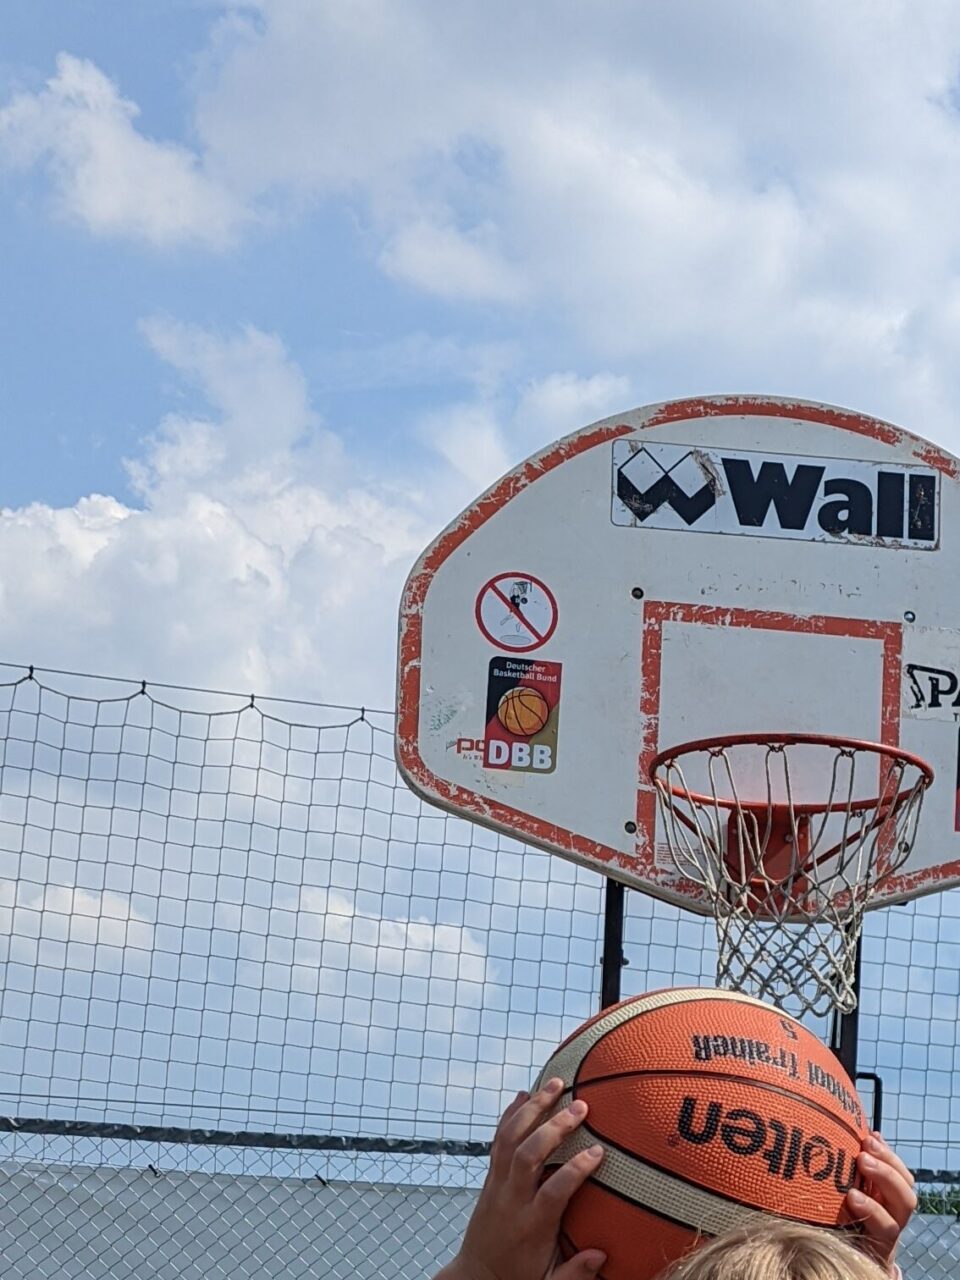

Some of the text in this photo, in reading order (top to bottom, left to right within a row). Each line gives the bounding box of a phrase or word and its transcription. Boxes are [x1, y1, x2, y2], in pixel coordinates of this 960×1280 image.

[721, 458, 936, 541] Wall
[493, 669, 558, 682] Basketball Bund
[506, 661, 546, 673] Deutscher
[488, 739, 553, 769] DBB
